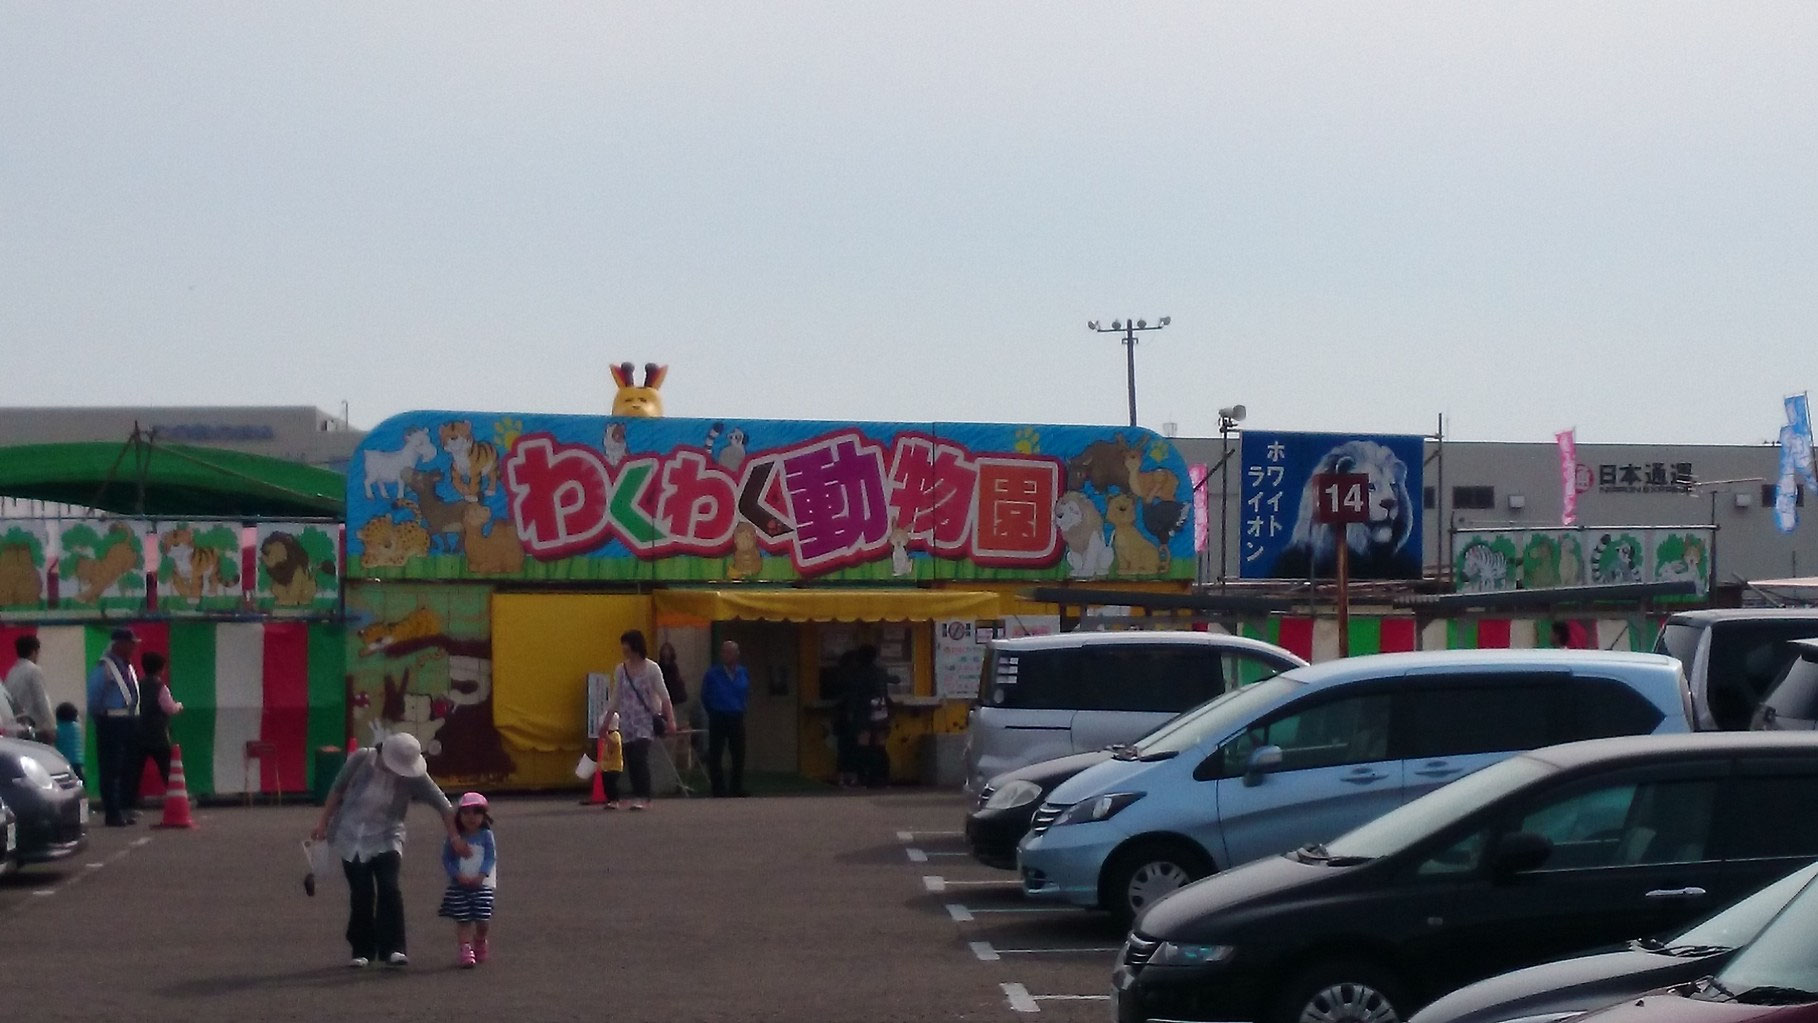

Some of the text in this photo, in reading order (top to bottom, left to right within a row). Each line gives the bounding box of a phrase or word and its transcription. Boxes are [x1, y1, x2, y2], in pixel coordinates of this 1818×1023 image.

[508, 431, 1063, 570] わくわく動物園
[1247, 466, 1264, 561] ライオン
[1267, 440, 1285, 537] ホワイト
[1325, 483, 1364, 513] 14
